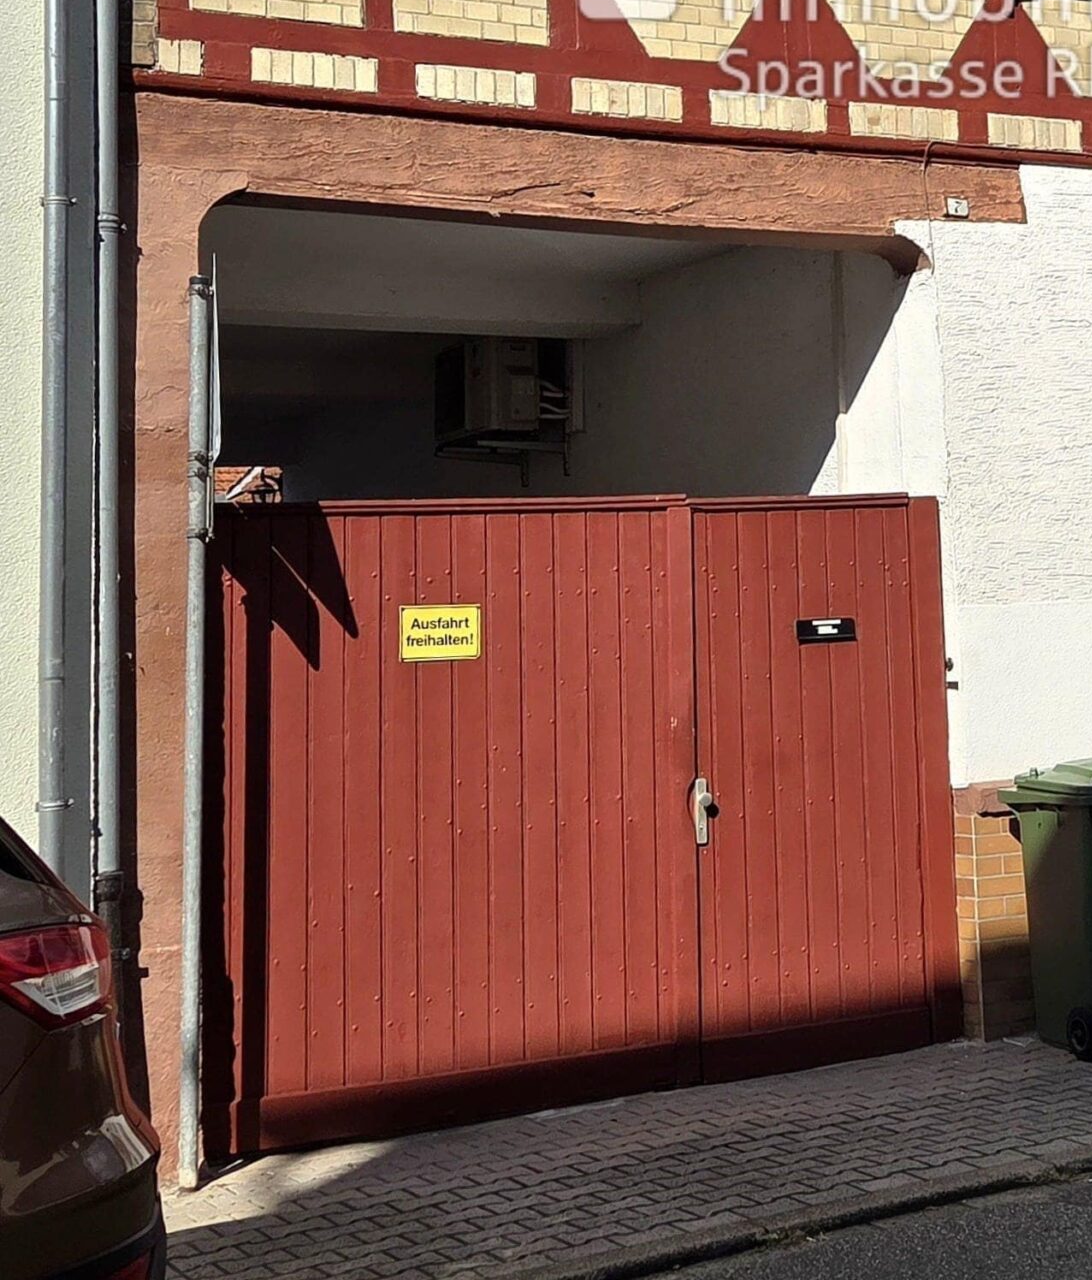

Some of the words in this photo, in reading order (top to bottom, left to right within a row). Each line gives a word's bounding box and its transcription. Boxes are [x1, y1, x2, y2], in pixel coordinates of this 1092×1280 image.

[954, 200, 963, 214] 7
[410, 617, 470, 630] Ausfahrt
[406, 633, 475, 648] freihalten!
